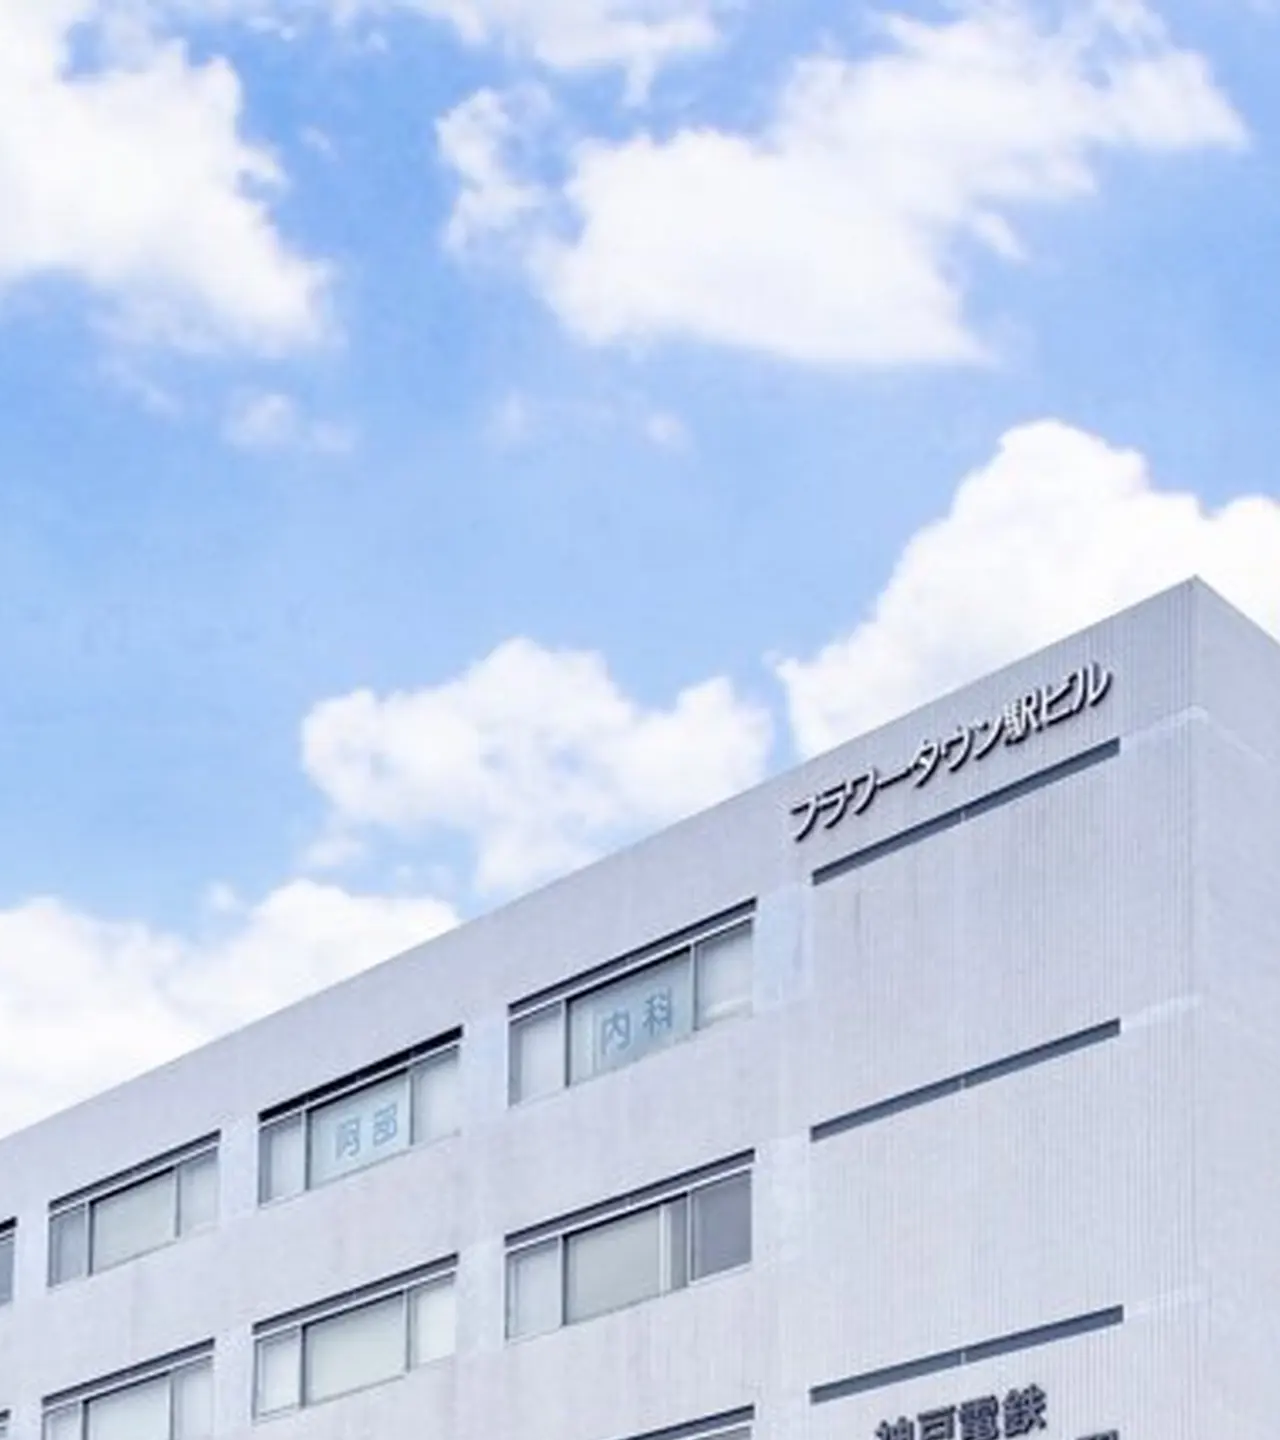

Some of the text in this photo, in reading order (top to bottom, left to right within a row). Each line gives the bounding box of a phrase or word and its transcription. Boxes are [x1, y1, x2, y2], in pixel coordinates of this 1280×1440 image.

[789, 662, 1114, 843] フラワータウン駅ビル
[601, 985, 674, 1056] 内科
